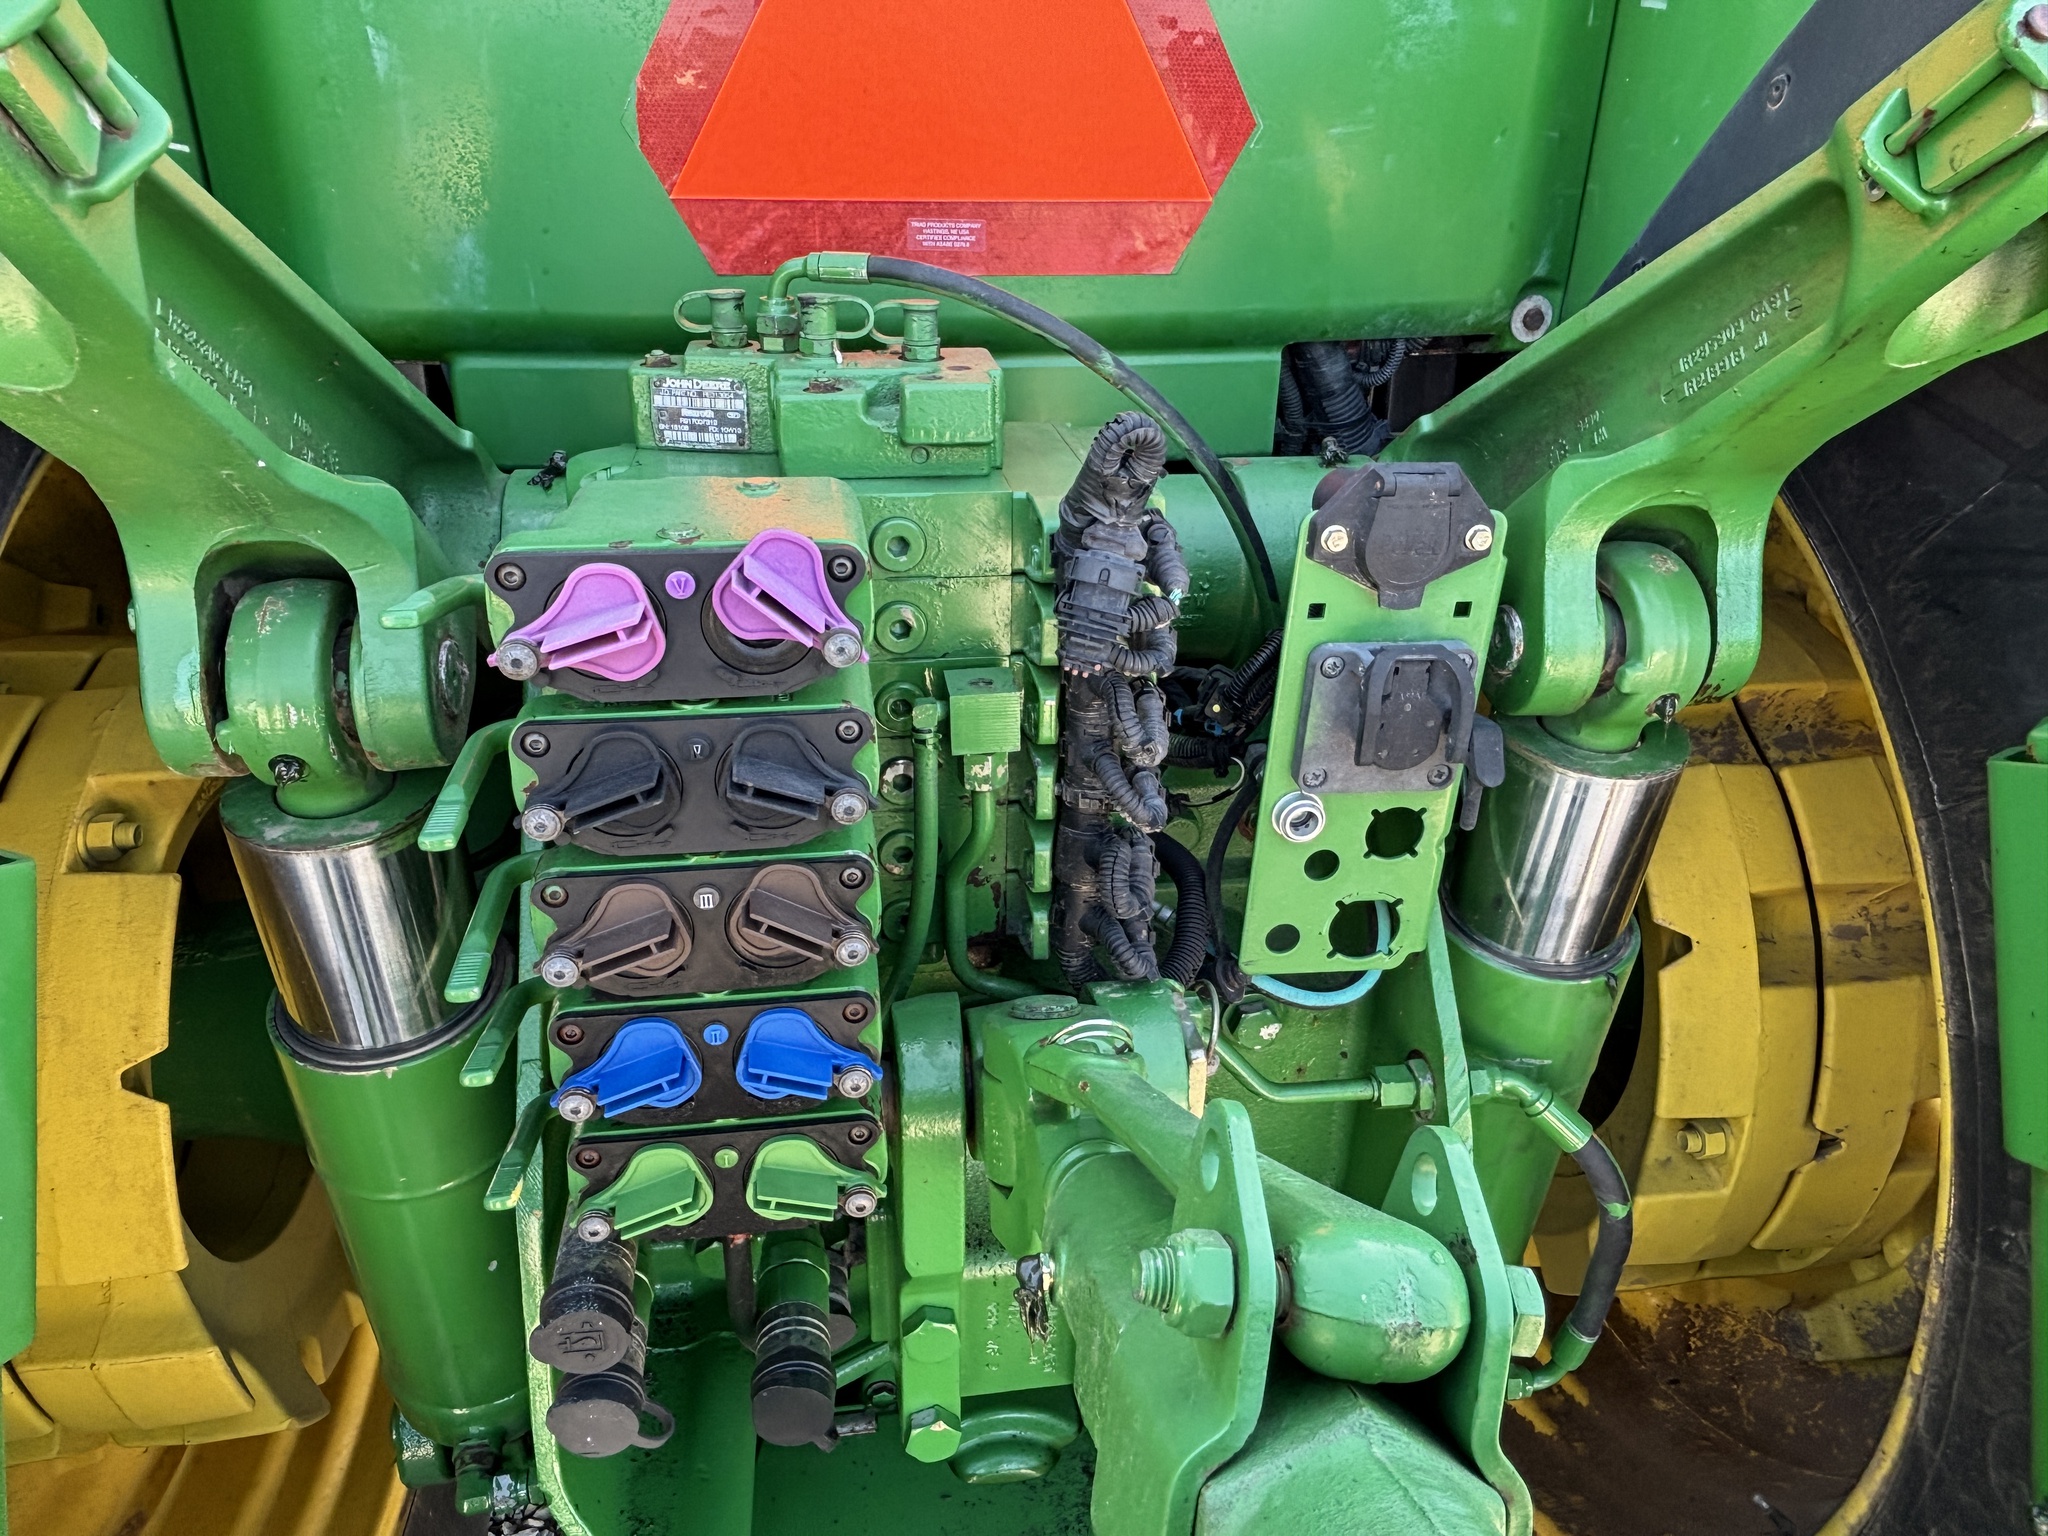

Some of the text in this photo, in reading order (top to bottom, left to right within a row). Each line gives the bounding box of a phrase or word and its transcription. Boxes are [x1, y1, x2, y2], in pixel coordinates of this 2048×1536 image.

[662, 377, 731, 390] JOHN DEERE
[671, 577, 686, 596] V
[699, 894, 714, 909] III
[710, 1030, 721, 1044] II
